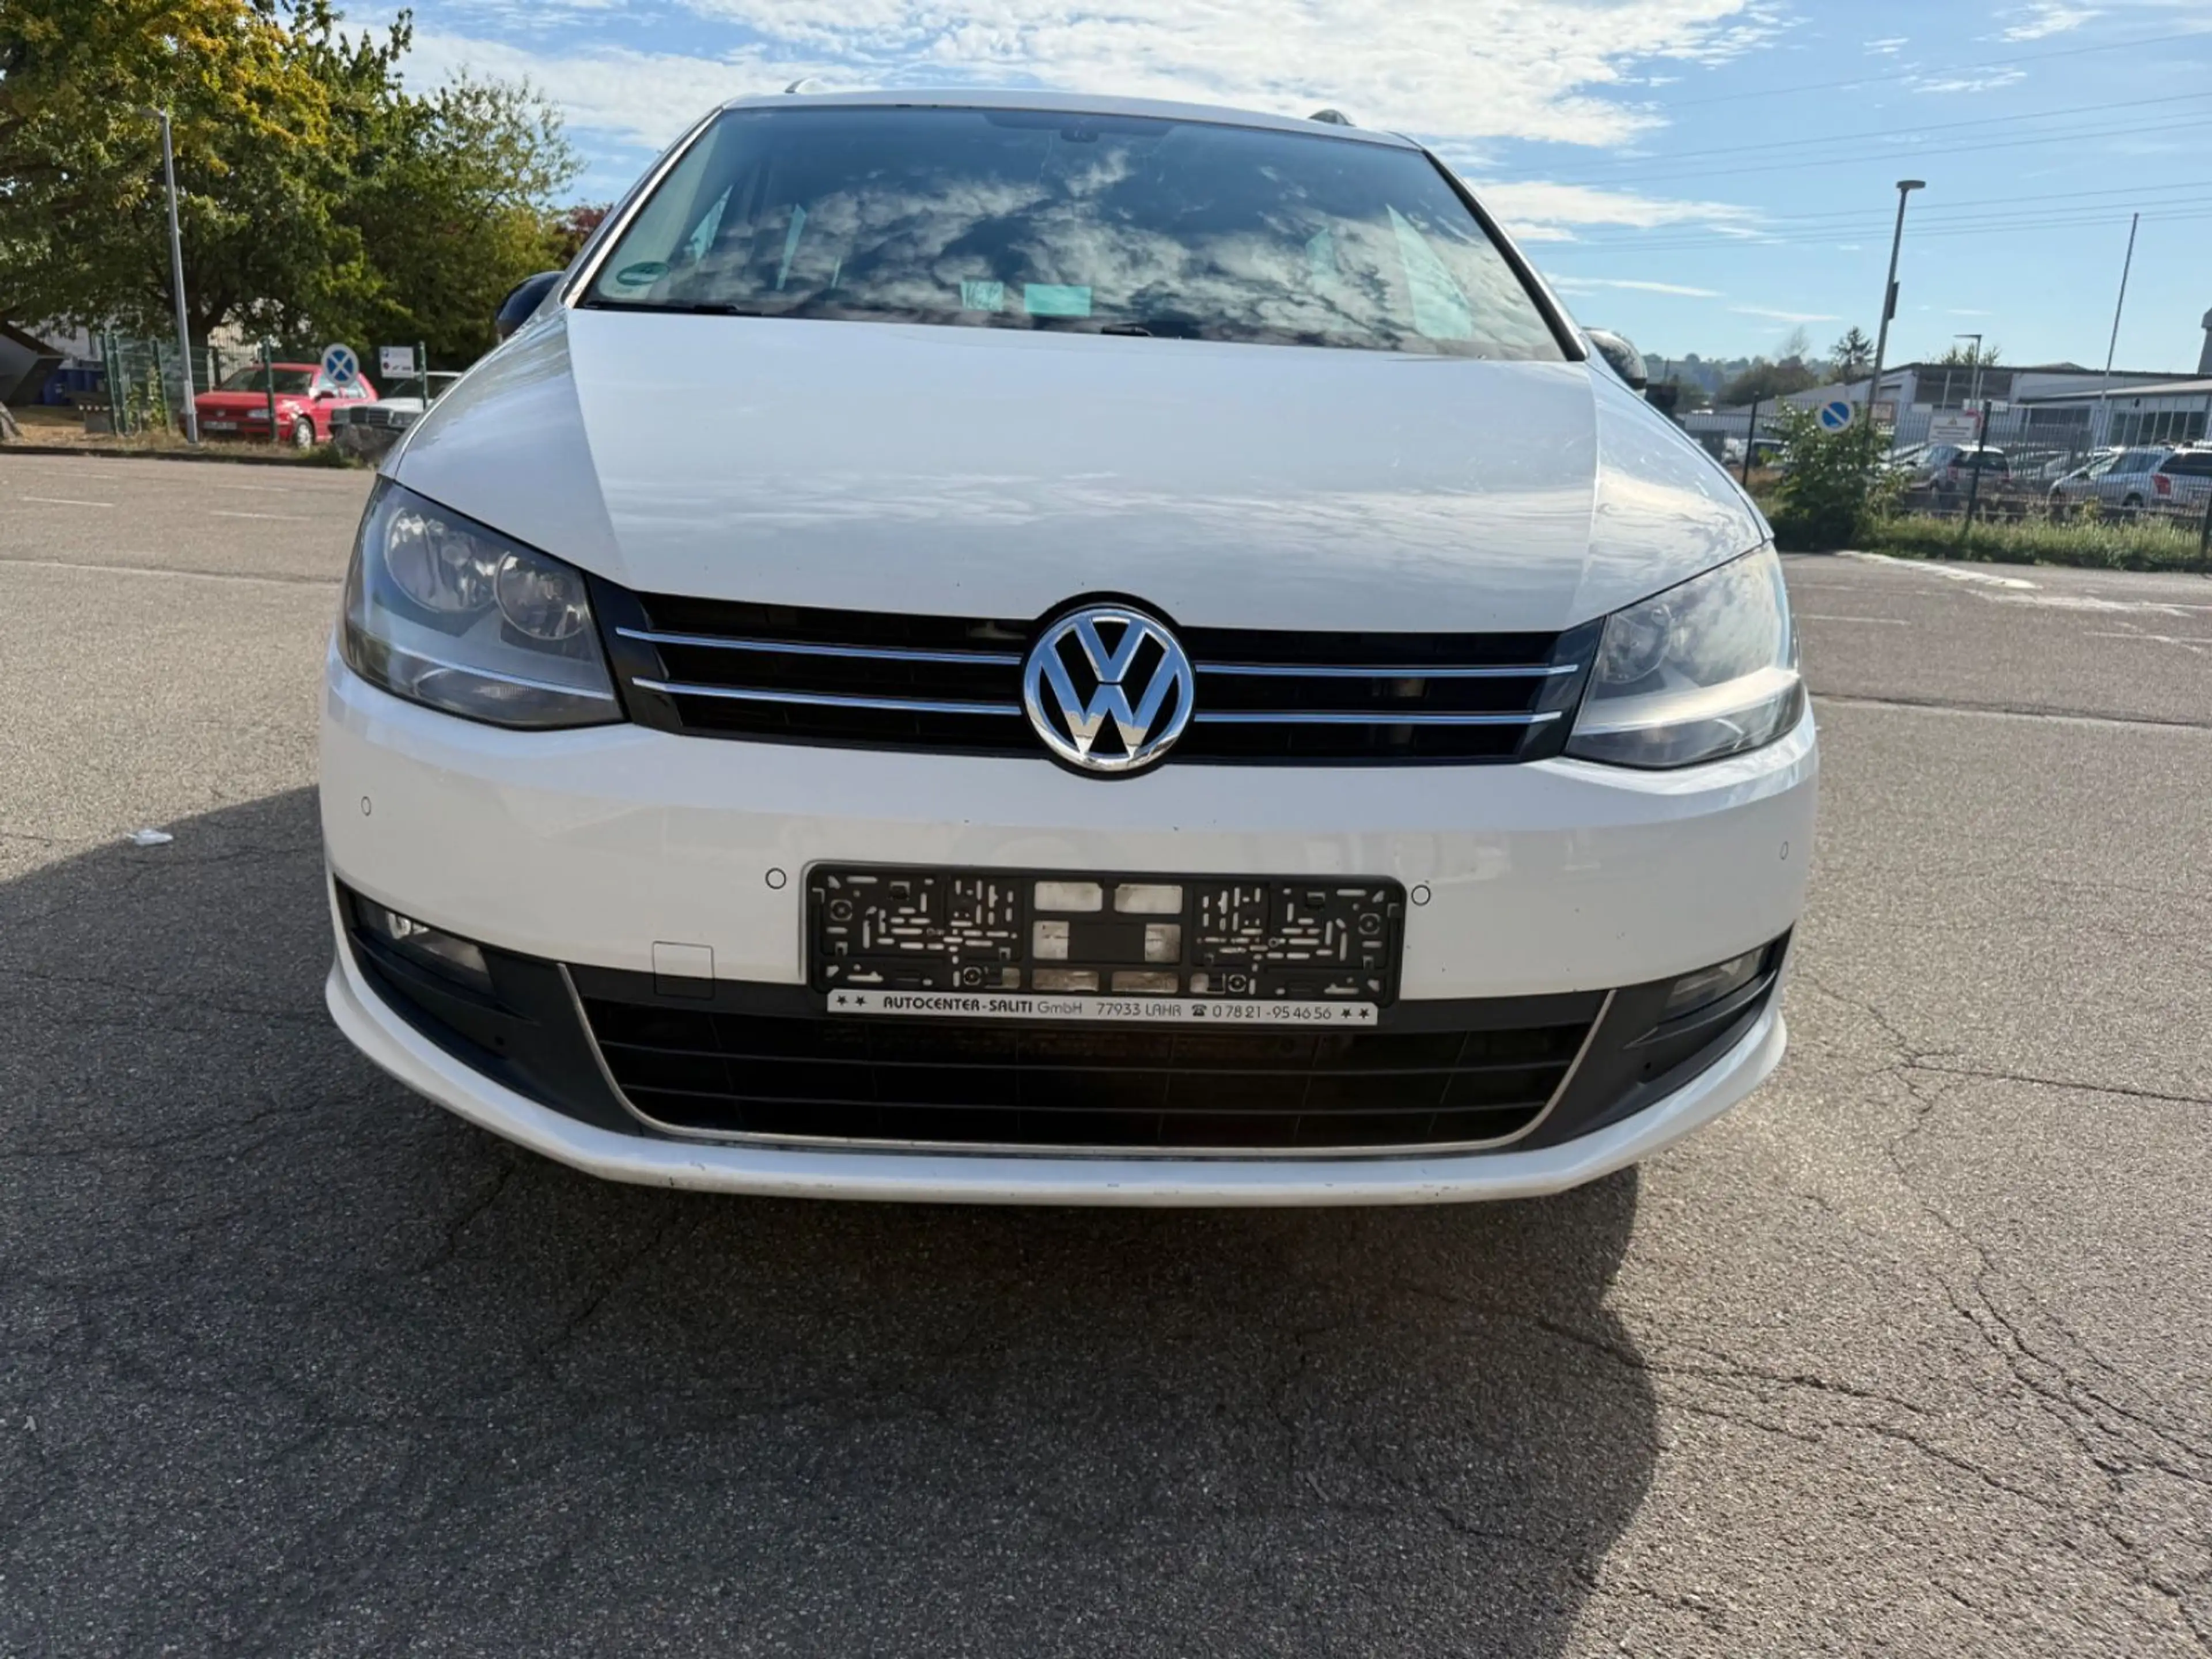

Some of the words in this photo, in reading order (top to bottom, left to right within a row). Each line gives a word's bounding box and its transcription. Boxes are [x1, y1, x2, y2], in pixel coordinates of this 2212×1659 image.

[882, 995, 1032, 1014] AUTOCENTER-SALITI
[1037, 1001, 1082, 1014] GmbH
[1096, 1002, 1141, 1016] 77933
[1146, 1003, 1181, 1017] LAHR
